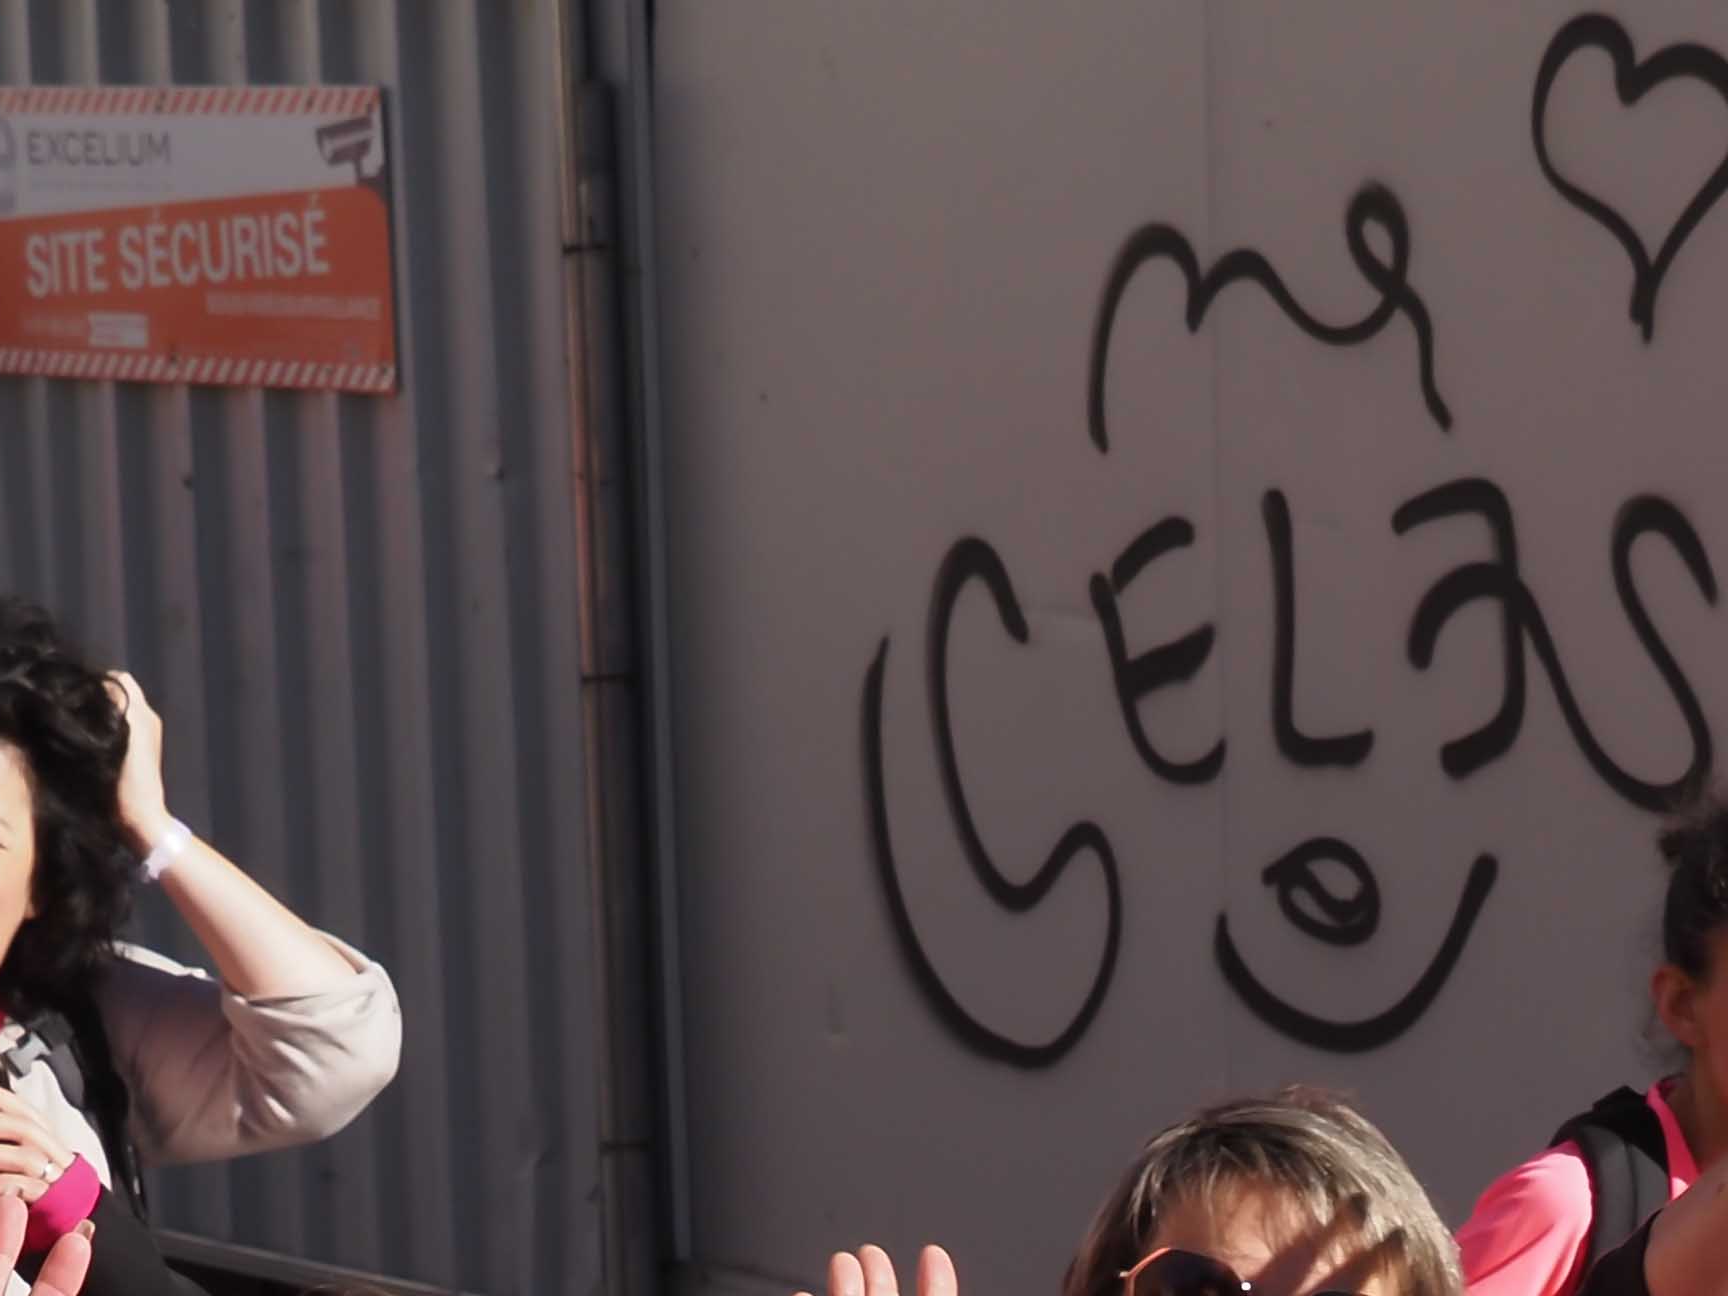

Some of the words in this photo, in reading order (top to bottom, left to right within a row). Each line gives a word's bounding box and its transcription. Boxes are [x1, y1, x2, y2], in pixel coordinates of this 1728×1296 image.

[27, 131, 171, 166] EXCELIUM
[25, 228, 109, 297] SITE
[119, 194, 330, 290] SÉCURISÉ
